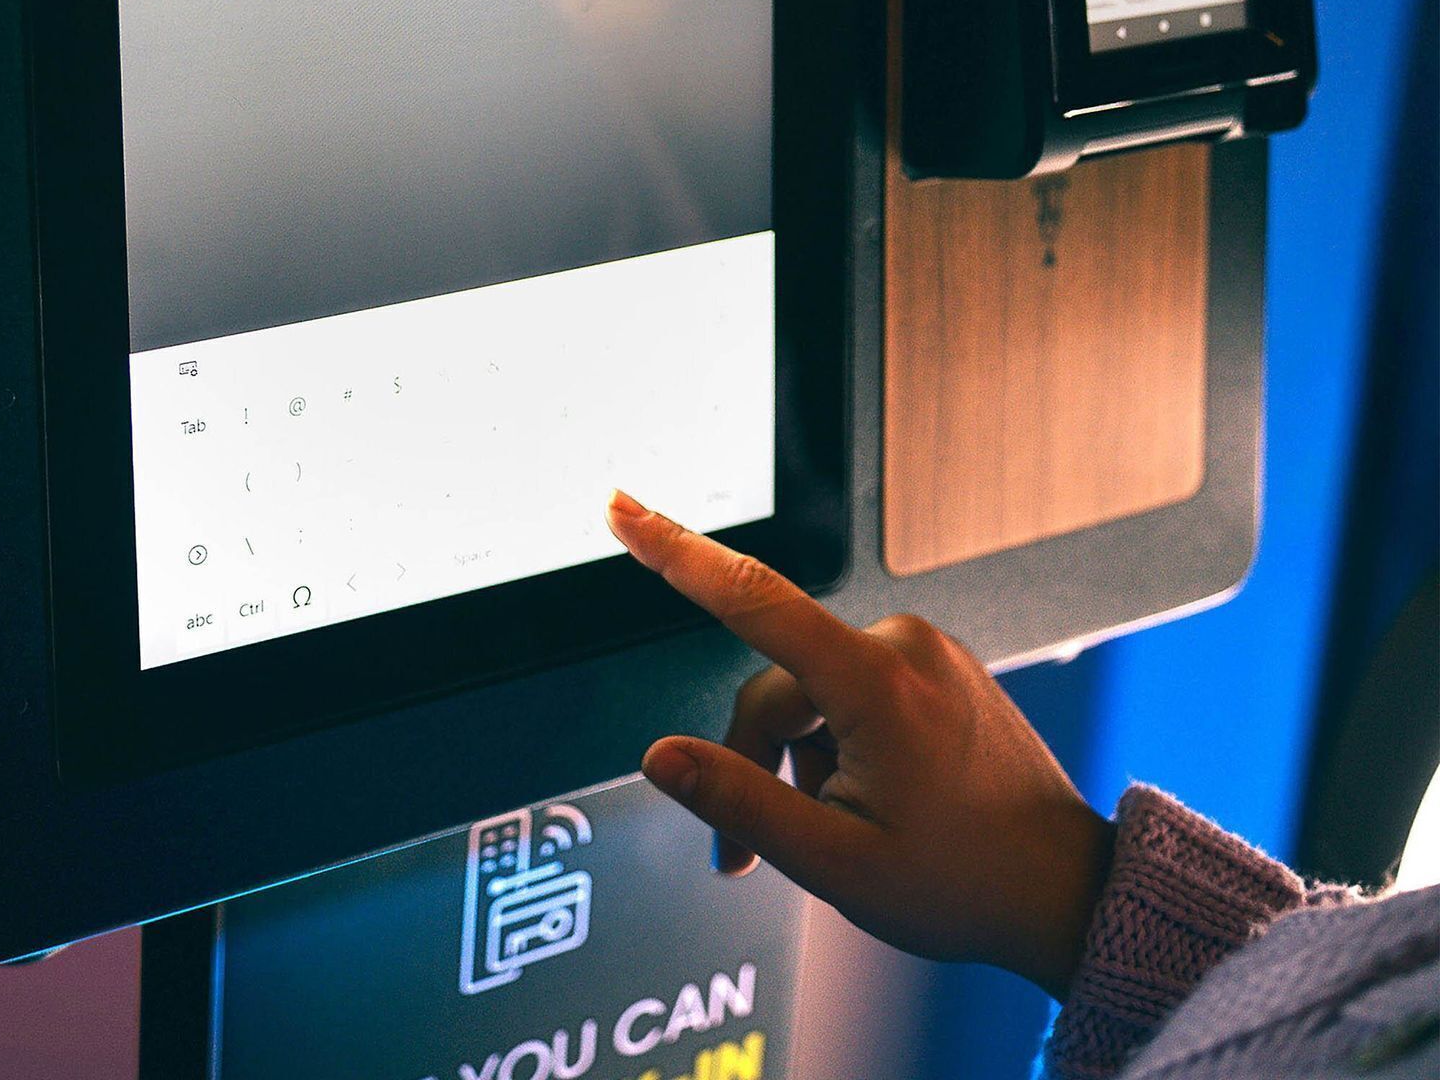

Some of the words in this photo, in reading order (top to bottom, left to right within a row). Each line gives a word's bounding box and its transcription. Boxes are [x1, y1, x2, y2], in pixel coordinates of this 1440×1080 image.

[181, 418, 207, 435] Tab
[288, 395, 307, 417] @
[186, 612, 215, 630] abc
[239, 600, 265, 618] Ctrl
[613, 961, 756, 1056] CAN
